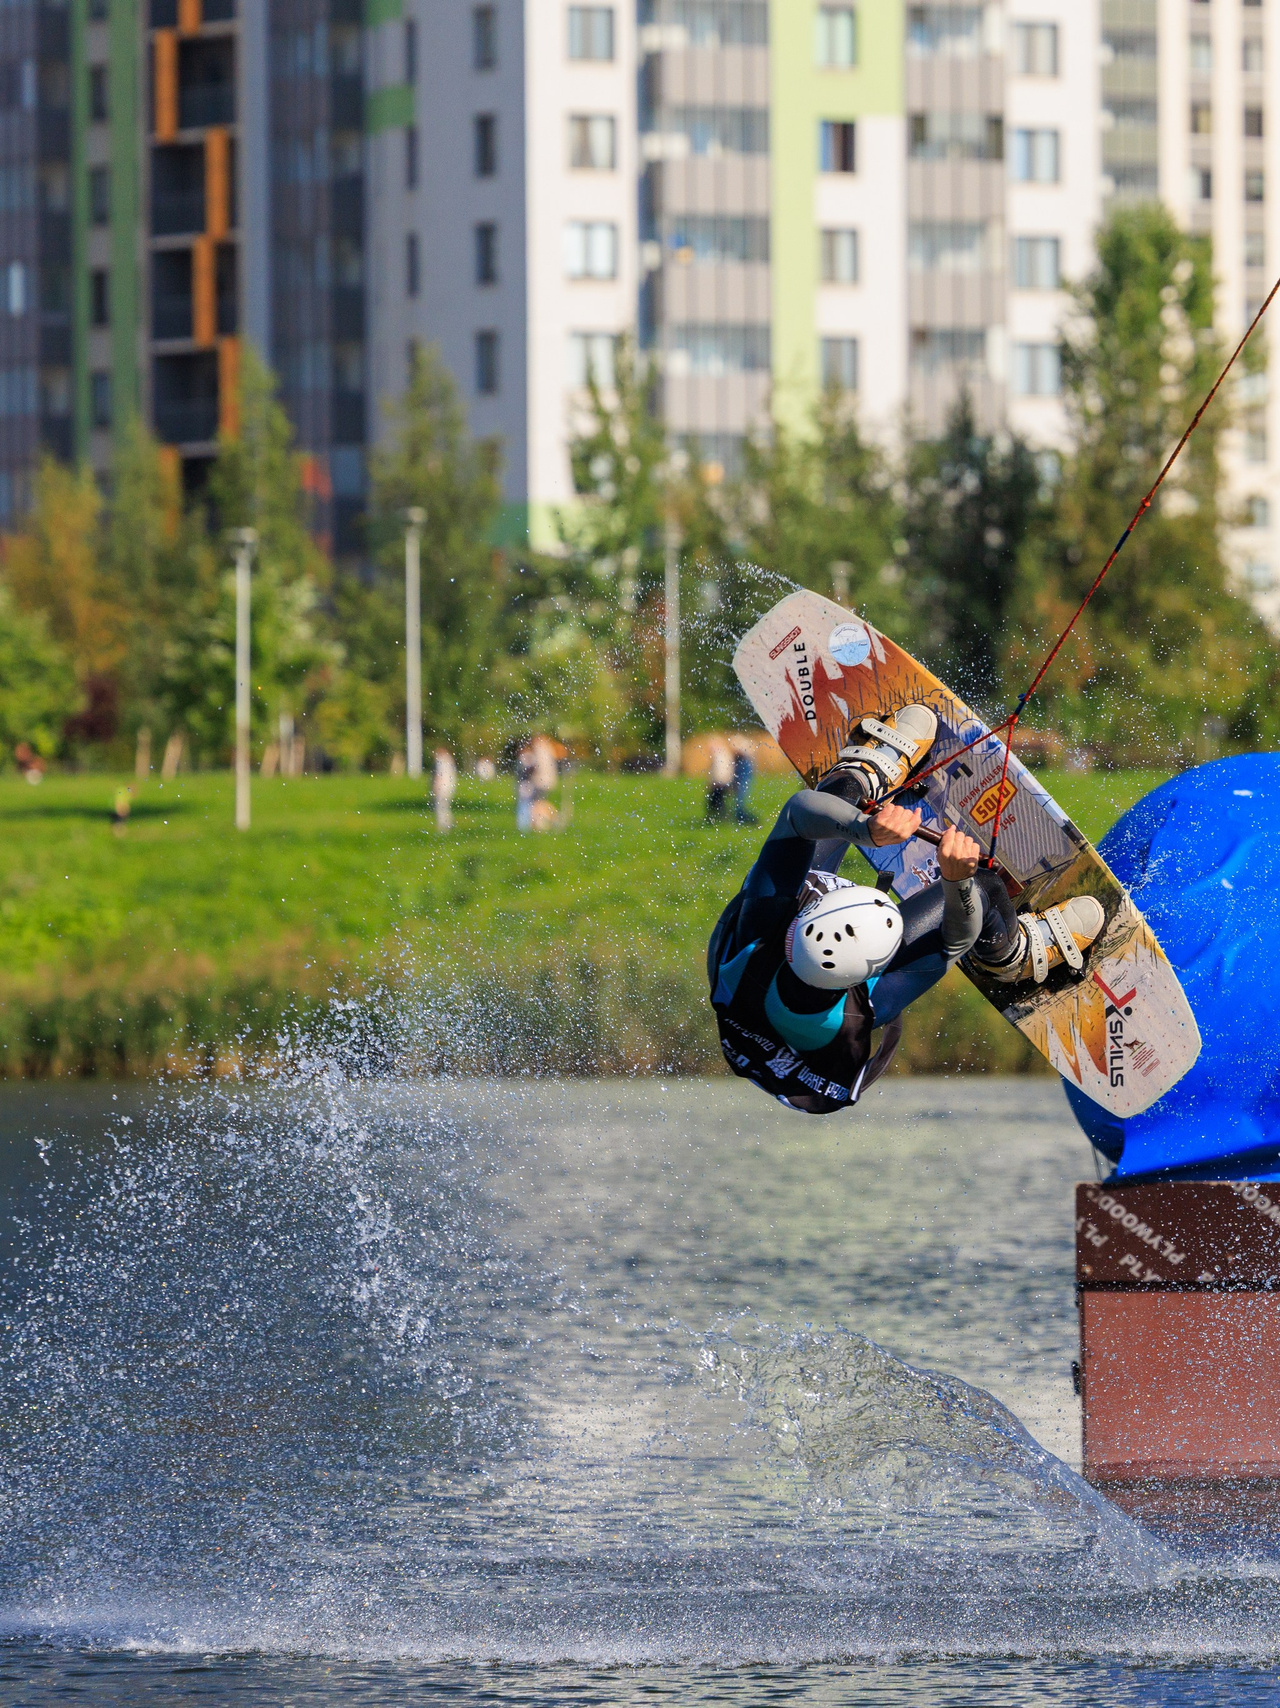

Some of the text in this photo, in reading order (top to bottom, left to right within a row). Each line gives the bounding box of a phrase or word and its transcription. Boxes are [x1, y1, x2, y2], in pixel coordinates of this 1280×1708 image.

[769, 626, 801, 659] SLINGSHOT
[794, 642, 817, 720] DOUBLE
[959, 765, 1003, 808] DYLAN MILLER
[1000, 813, 1017, 831] 146
[1109, 1019, 1124, 1088] SKILLS
[797, 1065, 826, 1093] WAKE
[1099, 1195, 1187, 1266] PLYWOOD
